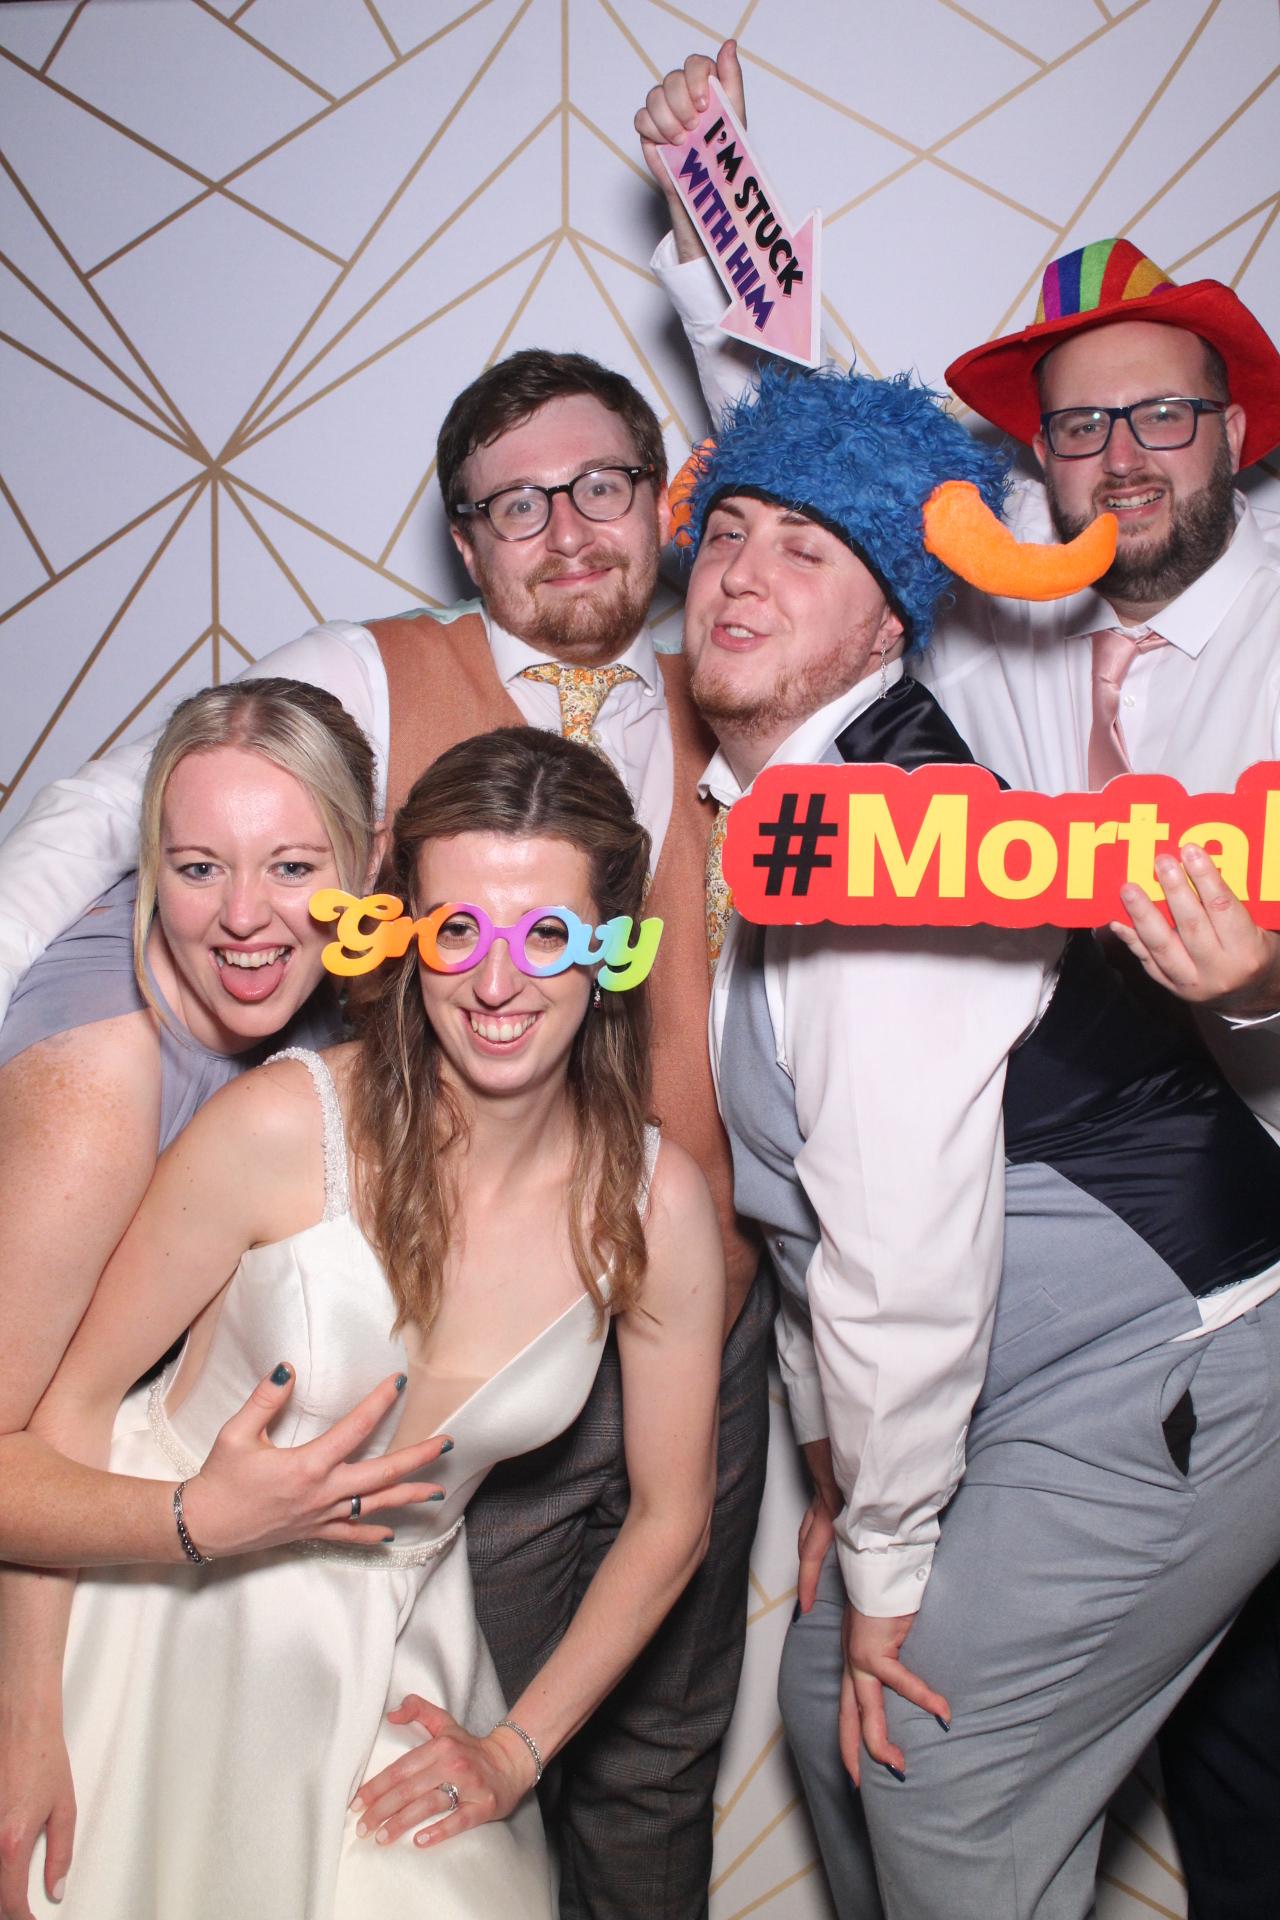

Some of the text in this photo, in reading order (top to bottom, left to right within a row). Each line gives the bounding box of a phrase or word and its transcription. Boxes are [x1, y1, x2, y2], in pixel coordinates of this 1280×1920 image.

[679, 147, 775, 330] WITH HIM
[704, 117, 803, 297] I'M STUCK
